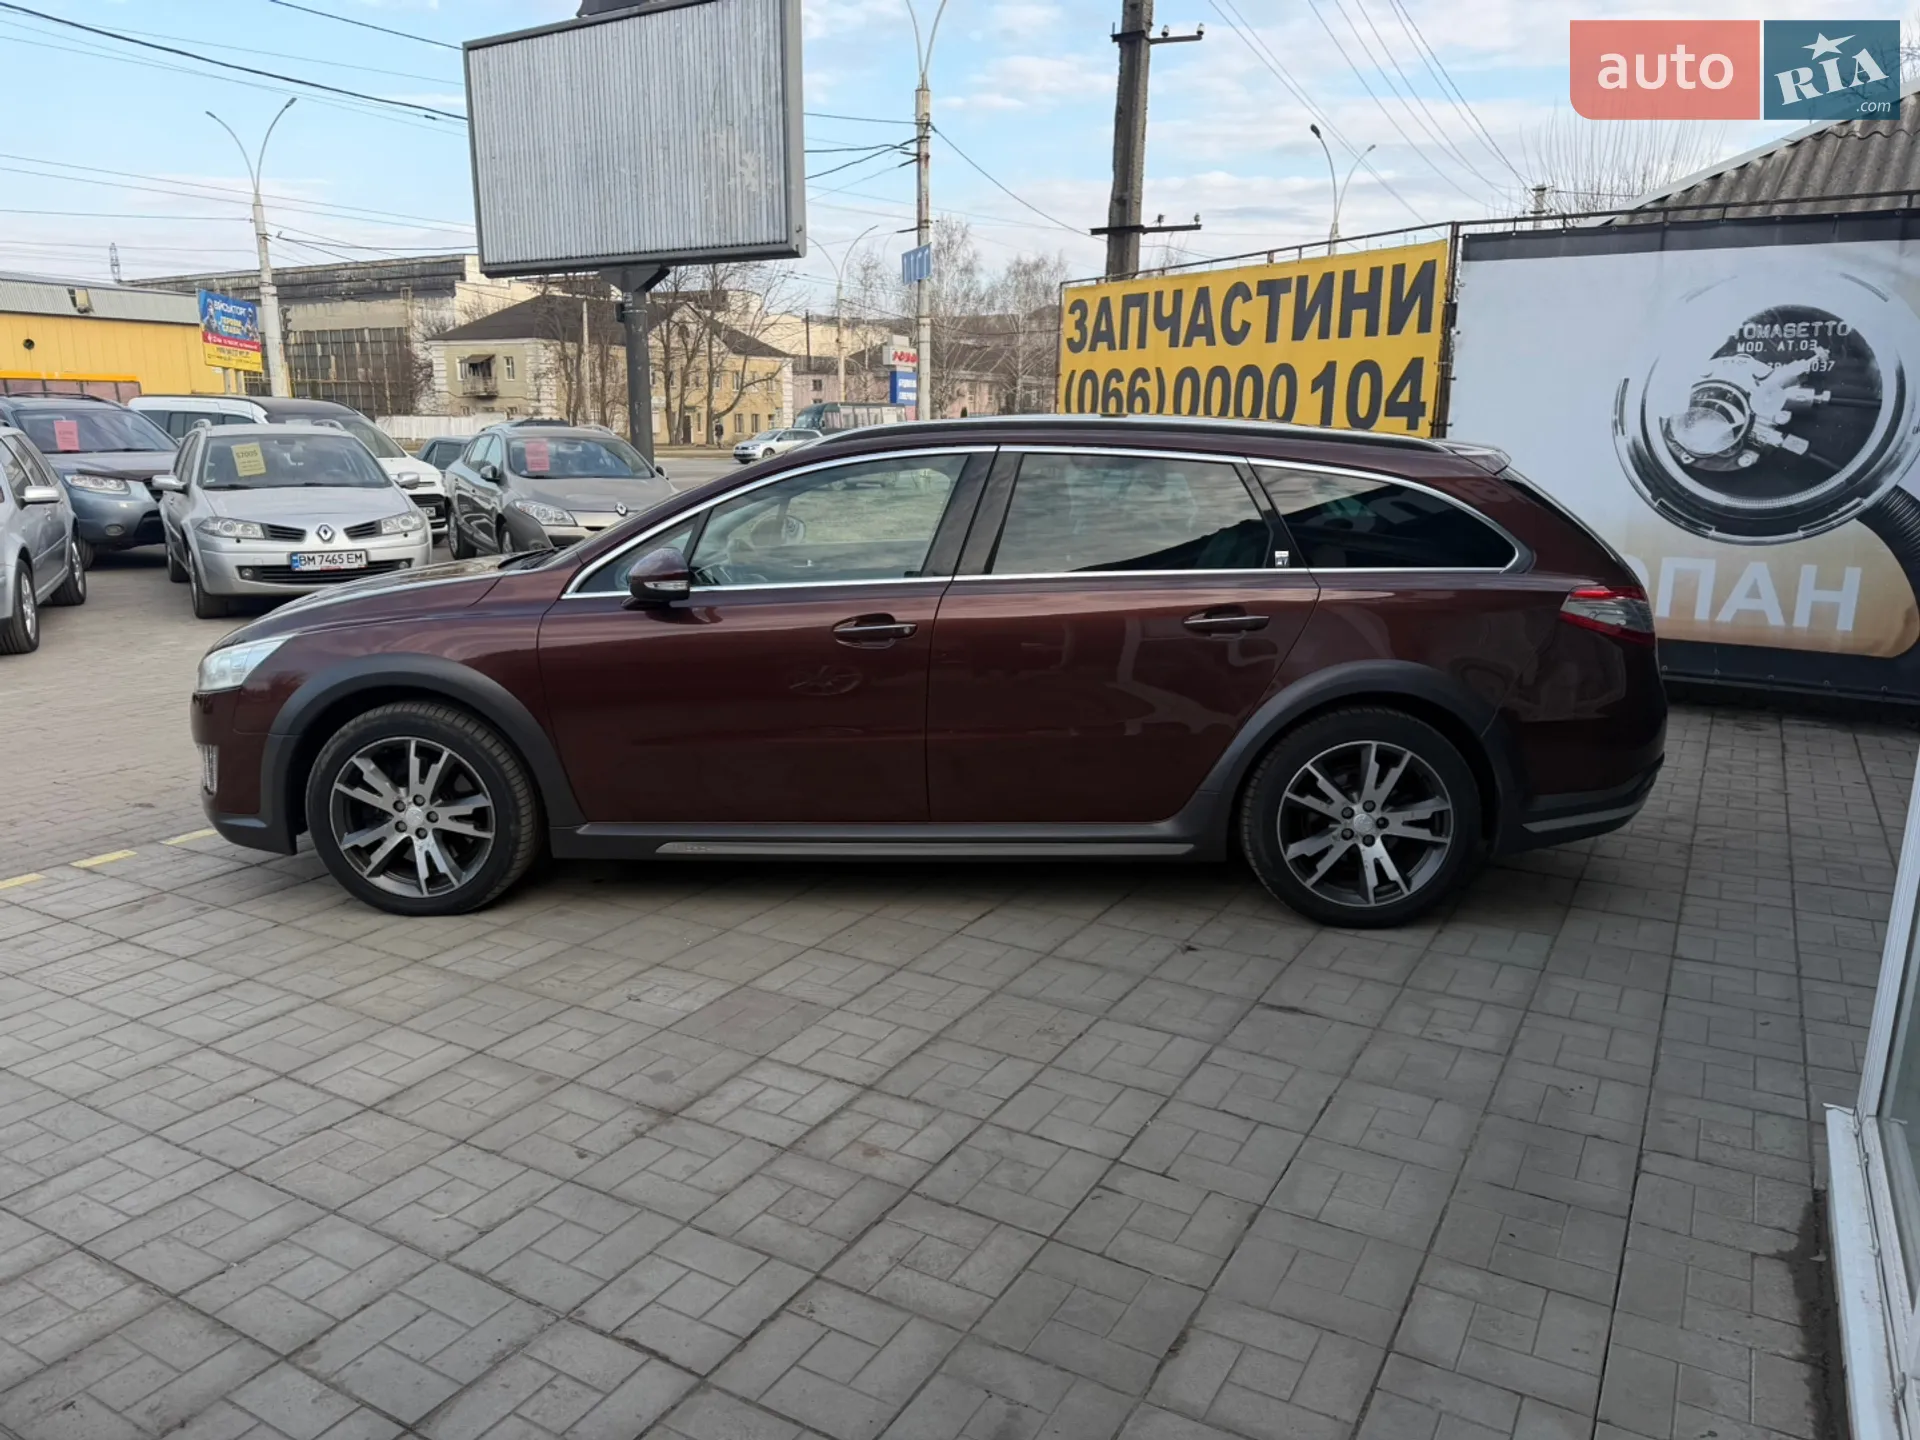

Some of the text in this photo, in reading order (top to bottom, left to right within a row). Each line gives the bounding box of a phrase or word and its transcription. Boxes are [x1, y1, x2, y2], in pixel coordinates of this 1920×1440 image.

[1066, 259, 1437, 354] ЗАПЧАСТИНИ
[1736, 341, 1767, 353] MOD.
[1807, 360, 1836, 372] 037
[299, 553, 363, 566] BM 7465 EM
[1622, 553, 1862, 632] ПАН
